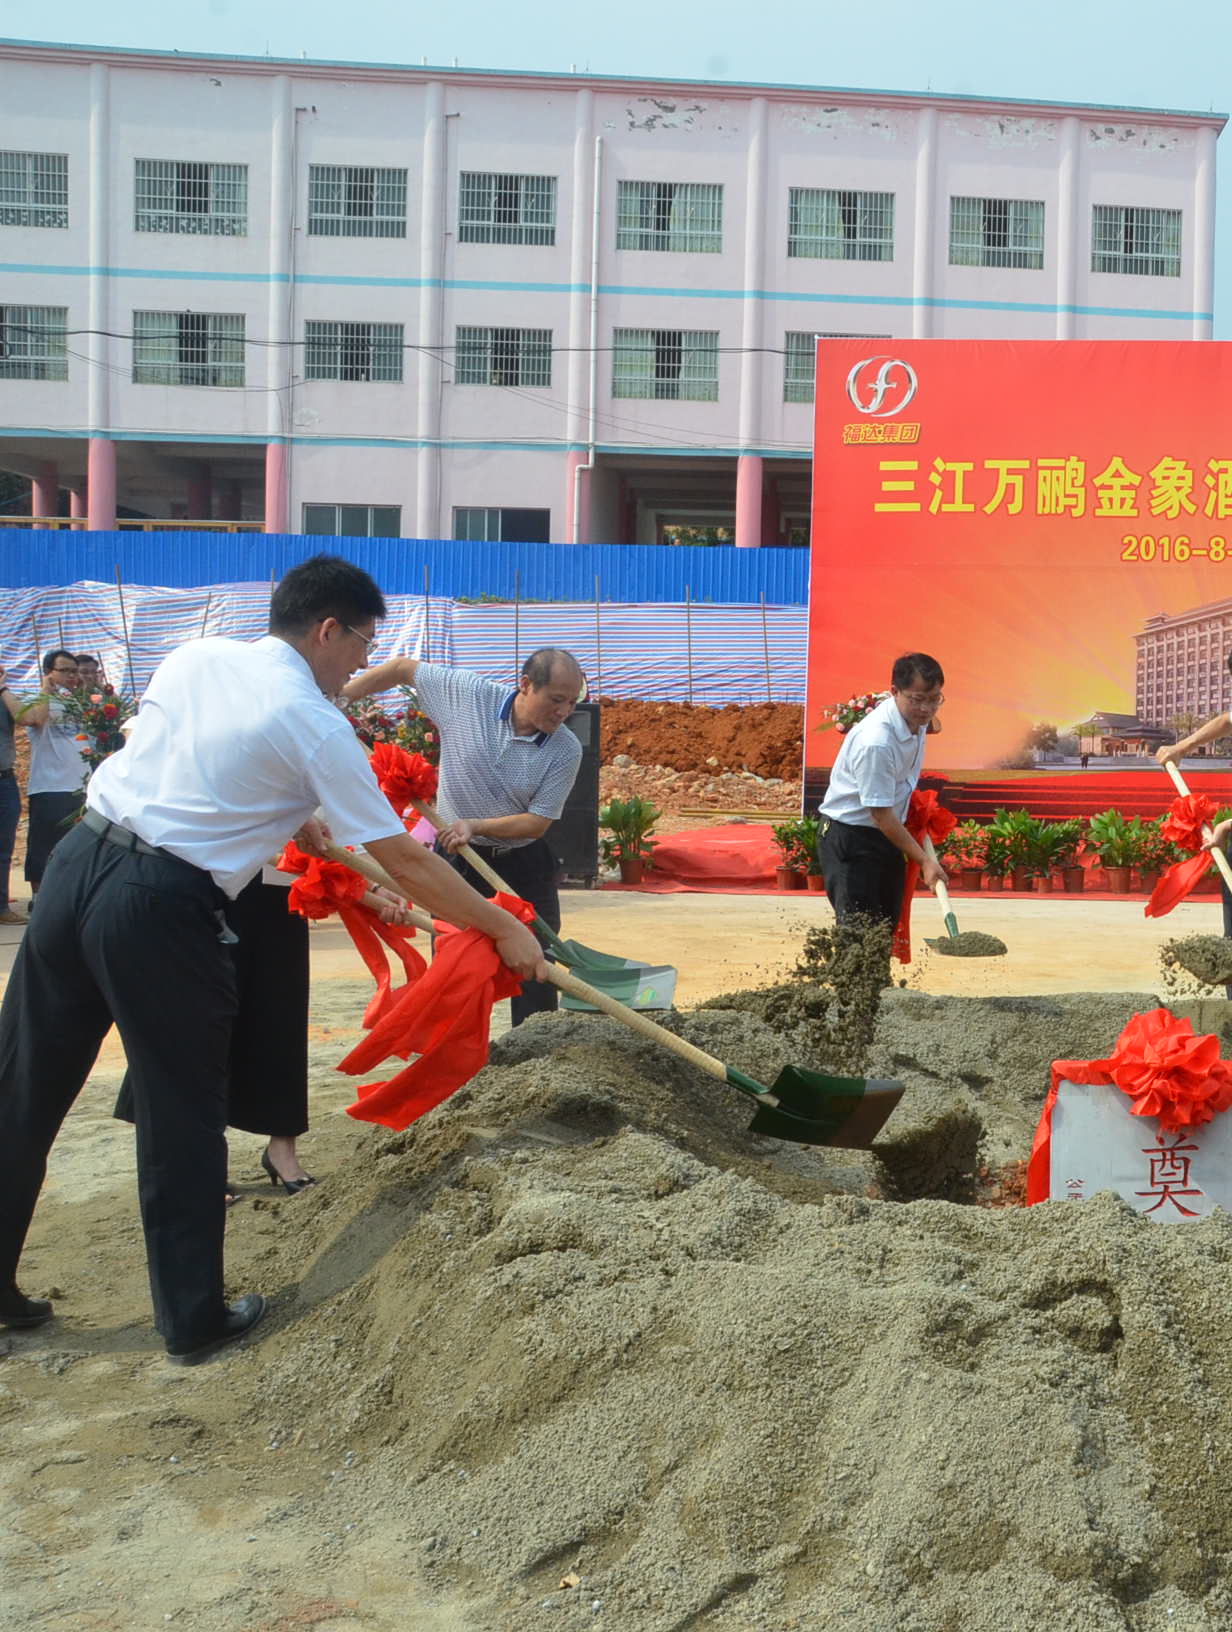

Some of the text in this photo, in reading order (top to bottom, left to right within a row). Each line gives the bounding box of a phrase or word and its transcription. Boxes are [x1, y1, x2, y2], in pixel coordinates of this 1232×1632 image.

[843, 423, 920, 445] 福达集团
[1134, 1133, 1204, 1217] 奠
